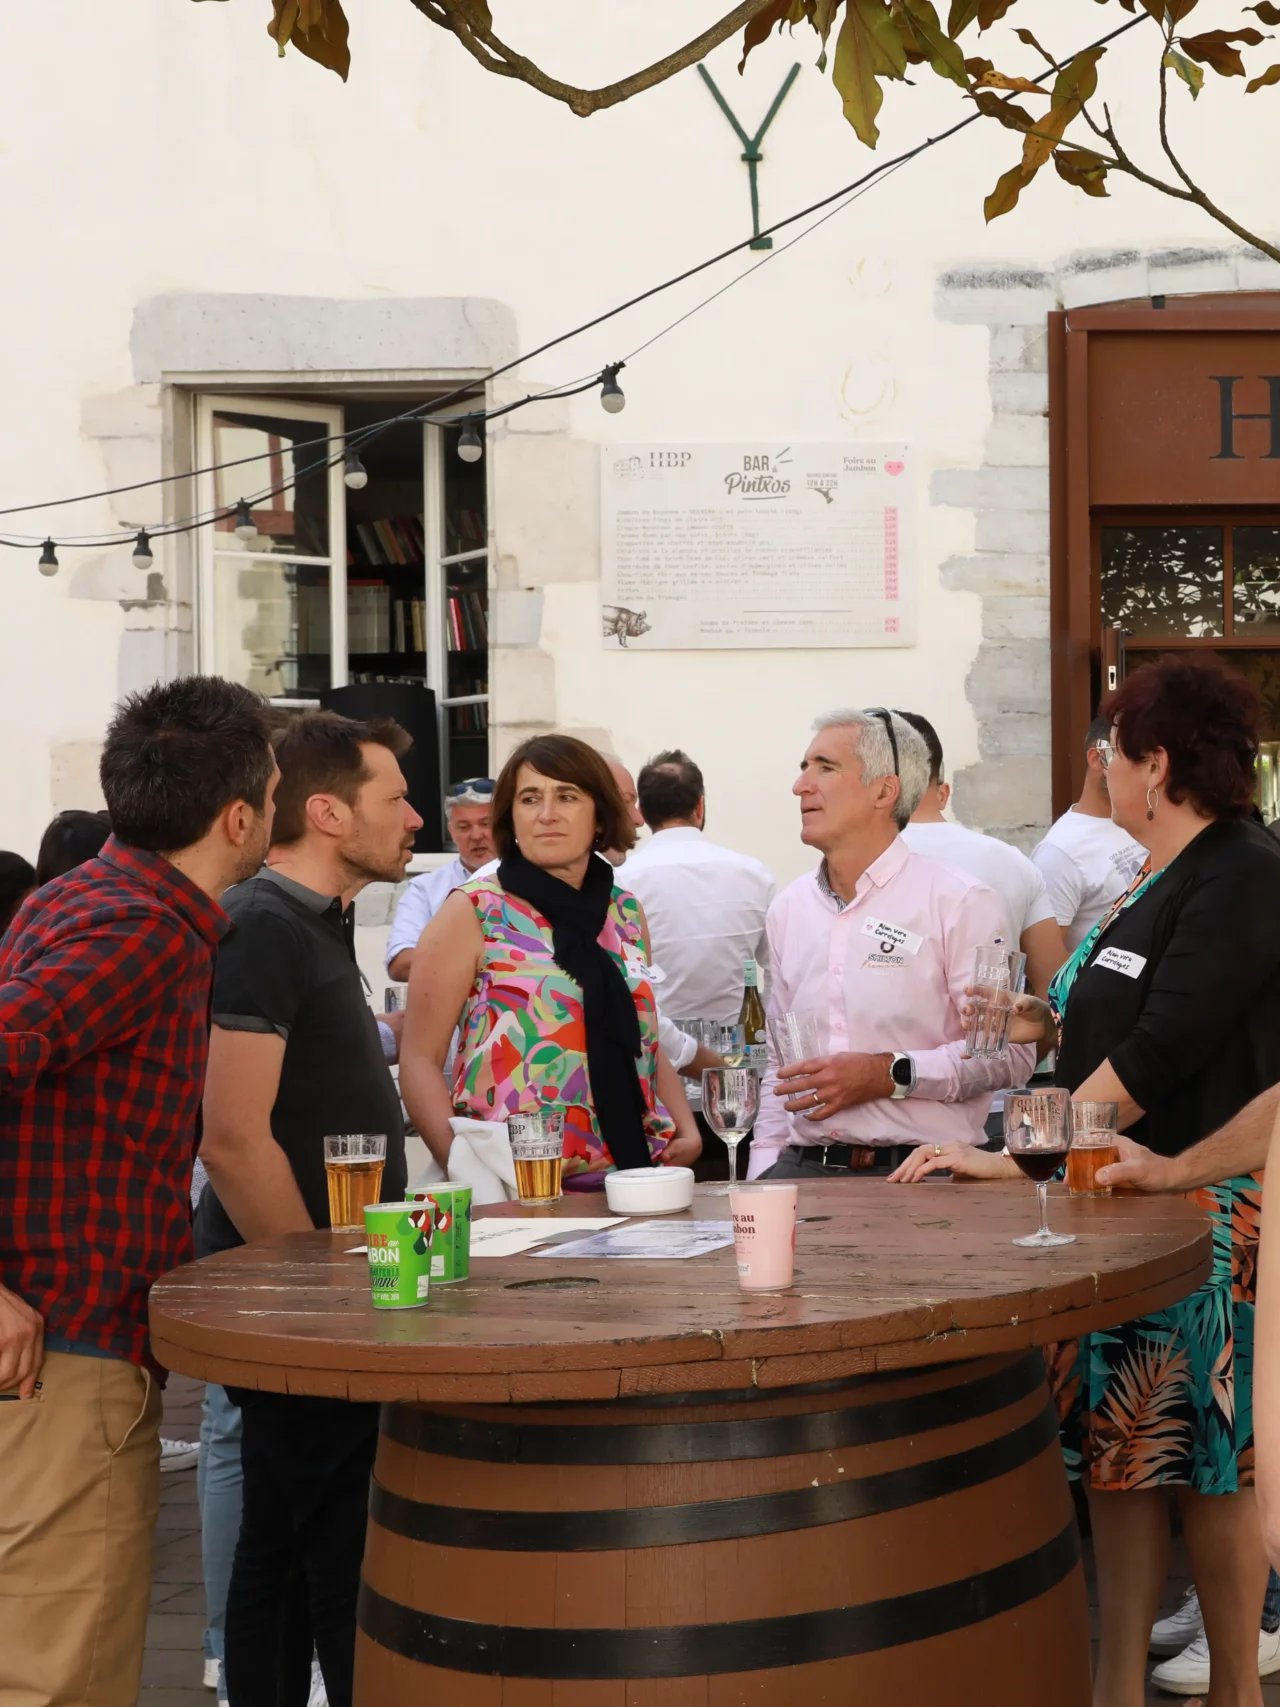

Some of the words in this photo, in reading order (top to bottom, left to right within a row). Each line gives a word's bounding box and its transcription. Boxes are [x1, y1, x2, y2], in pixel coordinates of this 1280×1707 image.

[649, 451, 692, 468] HBP
[744, 455, 770, 472] BAR
[843, 457, 863, 466] Foire
[865, 458, 877, 467] au
[844, 464, 876, 472] Jambon
[724, 472, 792, 495] Pintxos
[868, 953, 904, 965] SHILTON
[741, 1214, 755, 1222] au
[733, 1223, 756, 1234] bon
[367, 1233, 388, 1248] IRE
[371, 1277, 399, 1288] onne
